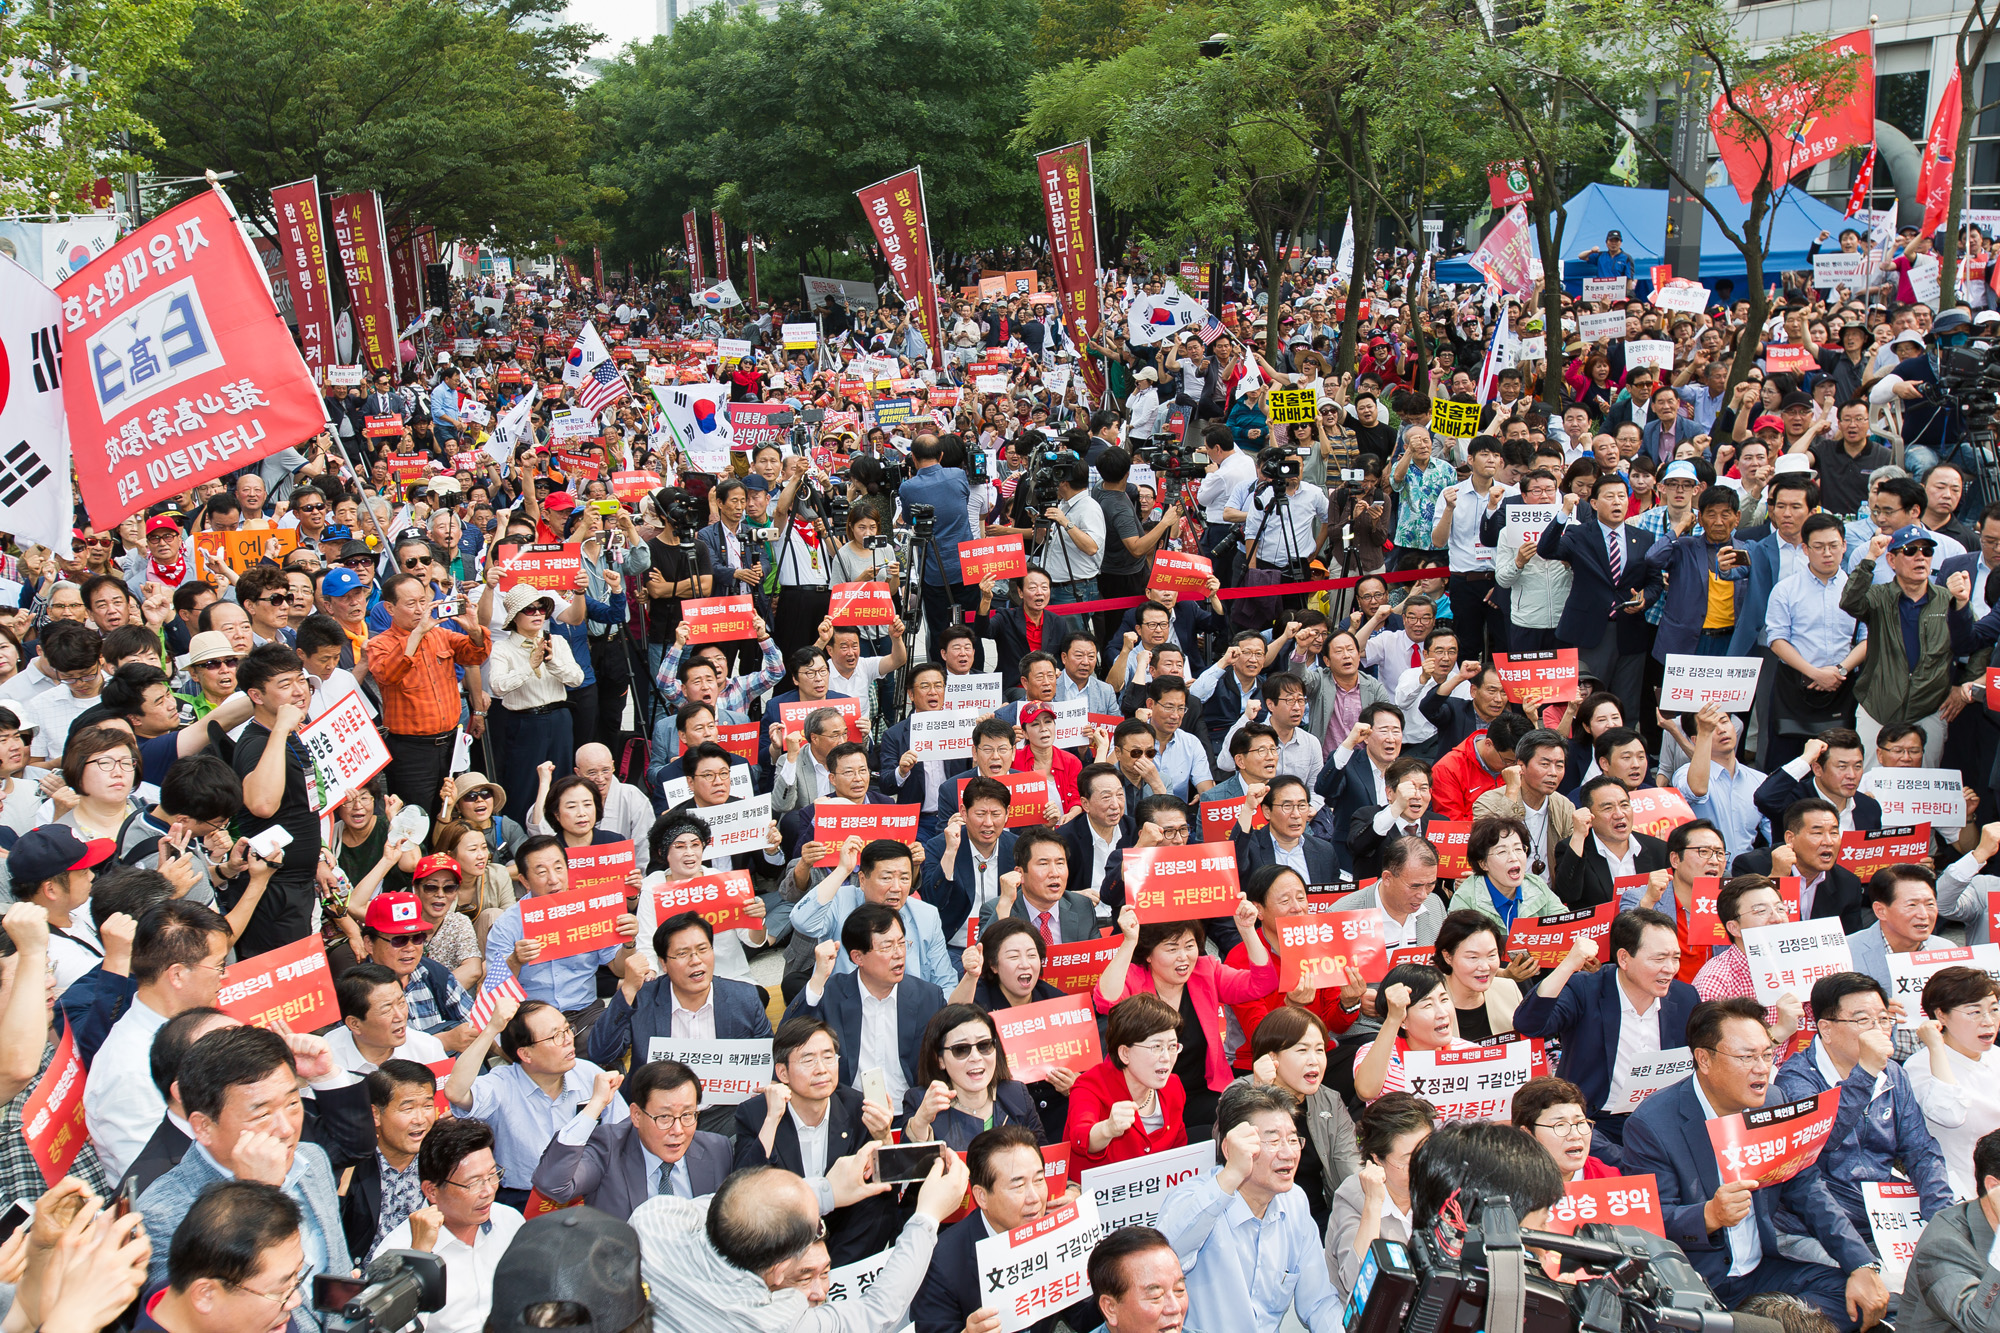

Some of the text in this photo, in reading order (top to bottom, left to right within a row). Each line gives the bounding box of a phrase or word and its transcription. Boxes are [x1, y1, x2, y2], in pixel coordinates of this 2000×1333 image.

[872, 197, 909, 289] 공영방송!
[284, 203, 313, 312] 한미동맹!
[352, 205, 373, 304] 사드배치!
[1779, 360, 1809, 368] STOP!
[1272, 391, 1315, 406] 전술핵
[735, 412, 767, 424] 대통령을
[1272, 406, 1316, 422] 재배치
[1434, 399, 1479, 420] 전술핵
[1434, 416, 1477, 437] 재배치
[1511, 511, 1552, 522] 공영방송
[960, 542, 1022, 559] 북한 김정은의 핵개발을
[502, 557, 579, 572] 文정권의 구걸안보
[966, 561, 1020, 577] 강력 규탄한다!
[1156, 558, 1192, 570] 북한 김정은의
[1156, 574, 1171, 583] 강력
[831, 590, 871, 600] 북한 김정은의
[684, 602, 753, 617] 북한 김정은의 핵개발을
[832, 607, 892, 618] 강력 규탄한다!
[691, 621, 750, 635] 강력 규탄한다!
[1499, 665, 1575, 682] 文정권의 구걸안보
[1667, 666, 1756, 678] 북한 김정은의 핵개발을
[947, 680, 1000, 692] 김정은의 핵개발을
[1671, 687, 1746, 703] 강력 규탄한다!
[957, 698, 995, 710] 규탄한다!
[1066, 707, 1087, 719] 핵개발을
[331, 704, 367, 744] 장악음모
[926, 718, 955, 730] 김정은의
[730, 730, 757, 742] 핵개발을
[914, 739, 933, 752] 강력
[336, 744, 374, 779] 중단하라!
[1015, 780, 1046, 795] 핵개발을
[1874, 779, 1962, 791] 북한 김정은의 핵개발을
[1658, 792, 1684, 810] 장악
[1883, 801, 1958, 816] 강력 규탄한다!
[708, 804, 770, 826] 김정은의 핵개발을
[818, 816, 916, 829] 북한 김정은의 핵개발을
[720, 827, 765, 846] 규탄한다!
[1428, 832, 1445, 844] 북한
[598, 851, 633, 866] 핵개발을
[1841, 841, 1927, 861] 文정권의 구걸안보
[1154, 855, 1235, 876] 김정은의 핵개발을
[660, 876, 750, 908] 공영방송 장악
[1137, 885, 1234, 909] 강력 규탄한다!
[524, 891, 624, 923] 북한 김정은의 핵개발을
[1576, 909, 1592, 919] 만드는
[535, 932, 560, 950] 강력
[1282, 919, 1375, 947] 공영방송 장악
[1512, 922, 1610, 947] 文정권의 구걸안보
[1778, 932, 1846, 954] 김정은의 핵개발을
[1052, 952, 1090, 967] 김정은의
[1950, 949, 1969, 959] 만드는
[1300, 953, 1359, 977] STOP!
[217, 951, 326, 1006] 김정은의 핵개발을
[1764, 970, 1796, 989] 강력
[1001, 1008, 1092, 1038] 김정은의 핵개발을
[1498, 1034, 1516, 1044] 만드는
[679, 1050, 771, 1066] 김정은의 핵개발을
[1026, 1039, 1091, 1066] 규탄한다!
[1440, 1048, 1502, 1062] 5천만 핵인질 만드는
[1631, 1065, 1651, 1077] 북한
[47, 1060, 78, 1114] 김정은의
[1410, 1068, 1528, 1096] 文정권의 구걸안보
[1750, 1101, 1815, 1123] 5천만 핵인질 만드는
[48, 1122, 72, 1164] 강력
[1721, 1116, 1832, 1171] 文정권의 구걸안보
[1094, 1176, 1161, 1207] 언론탄압
[1607, 1188, 1651, 1216] 장악
[1014, 1207, 1075, 1241] 5천만 핵인질 만드는
[1871, 1209, 1908, 1230] 文정권의
[986, 1253, 1048, 1293] 文정권의
